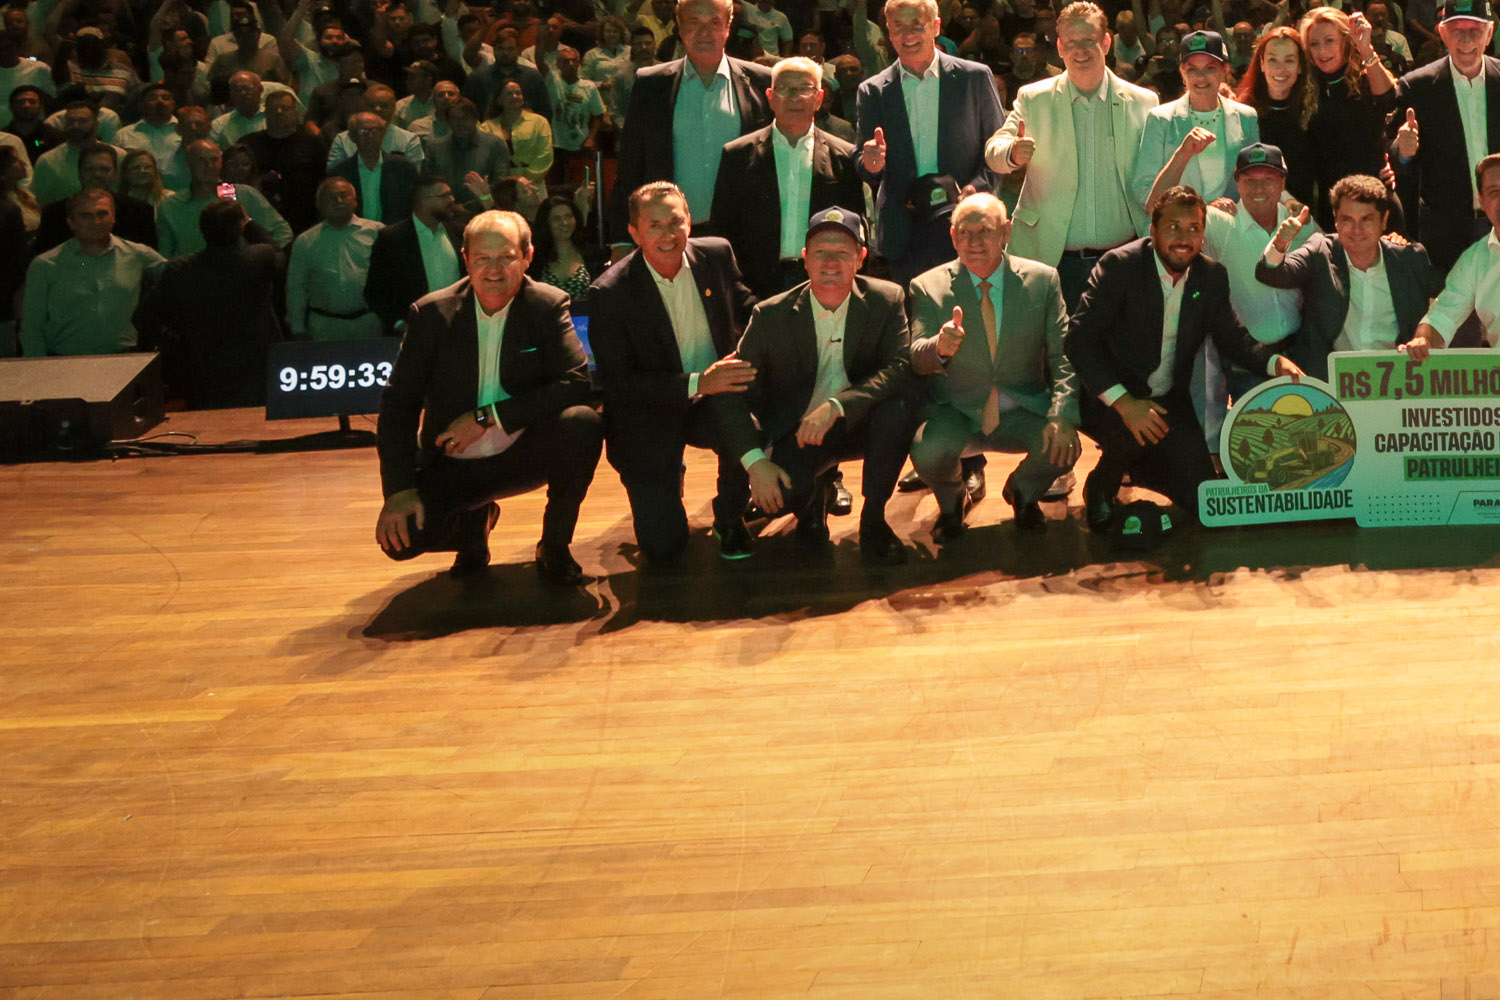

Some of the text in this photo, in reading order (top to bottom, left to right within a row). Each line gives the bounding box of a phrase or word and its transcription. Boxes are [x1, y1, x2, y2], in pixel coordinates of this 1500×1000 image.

[279, 361, 393, 392] 9:59:33
[1339, 370, 1371, 399] R$
[1376, 361, 1424, 400] 7,5
[1374, 431, 1494, 454] CAPACITAÇÃO
[1206, 489, 1353, 516] SUSTENTABILIDADE
